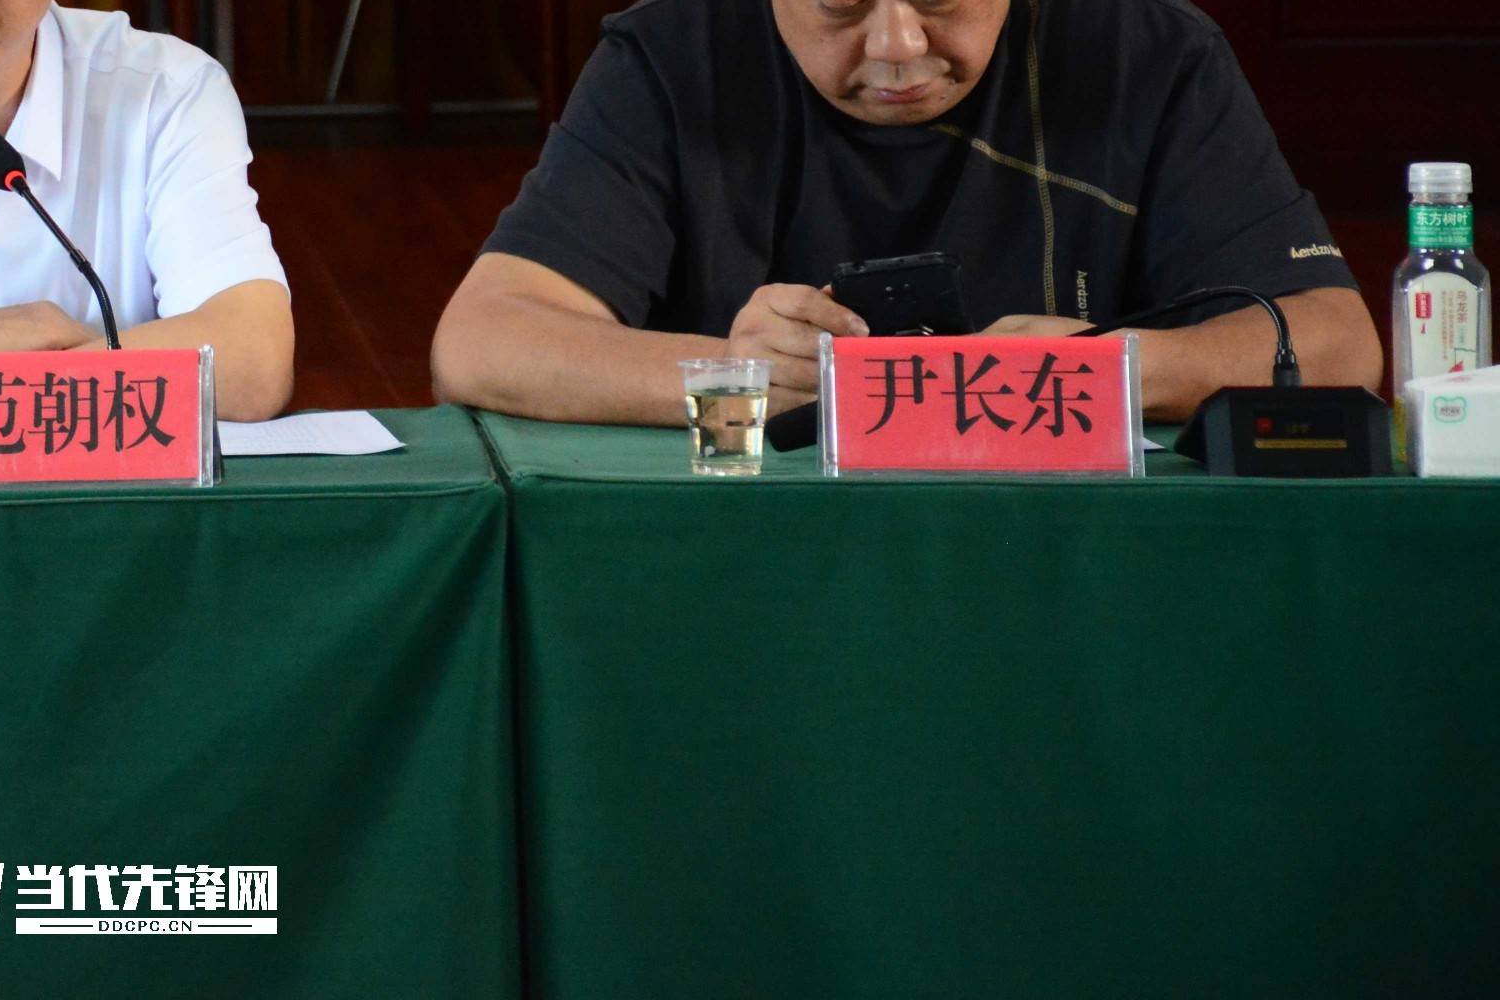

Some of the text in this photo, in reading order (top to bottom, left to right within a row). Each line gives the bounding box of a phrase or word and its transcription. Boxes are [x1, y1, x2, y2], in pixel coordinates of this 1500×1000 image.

[1416, 211, 1468, 226] 东方树叶
[864, 352, 1094, 437] 尹长东
